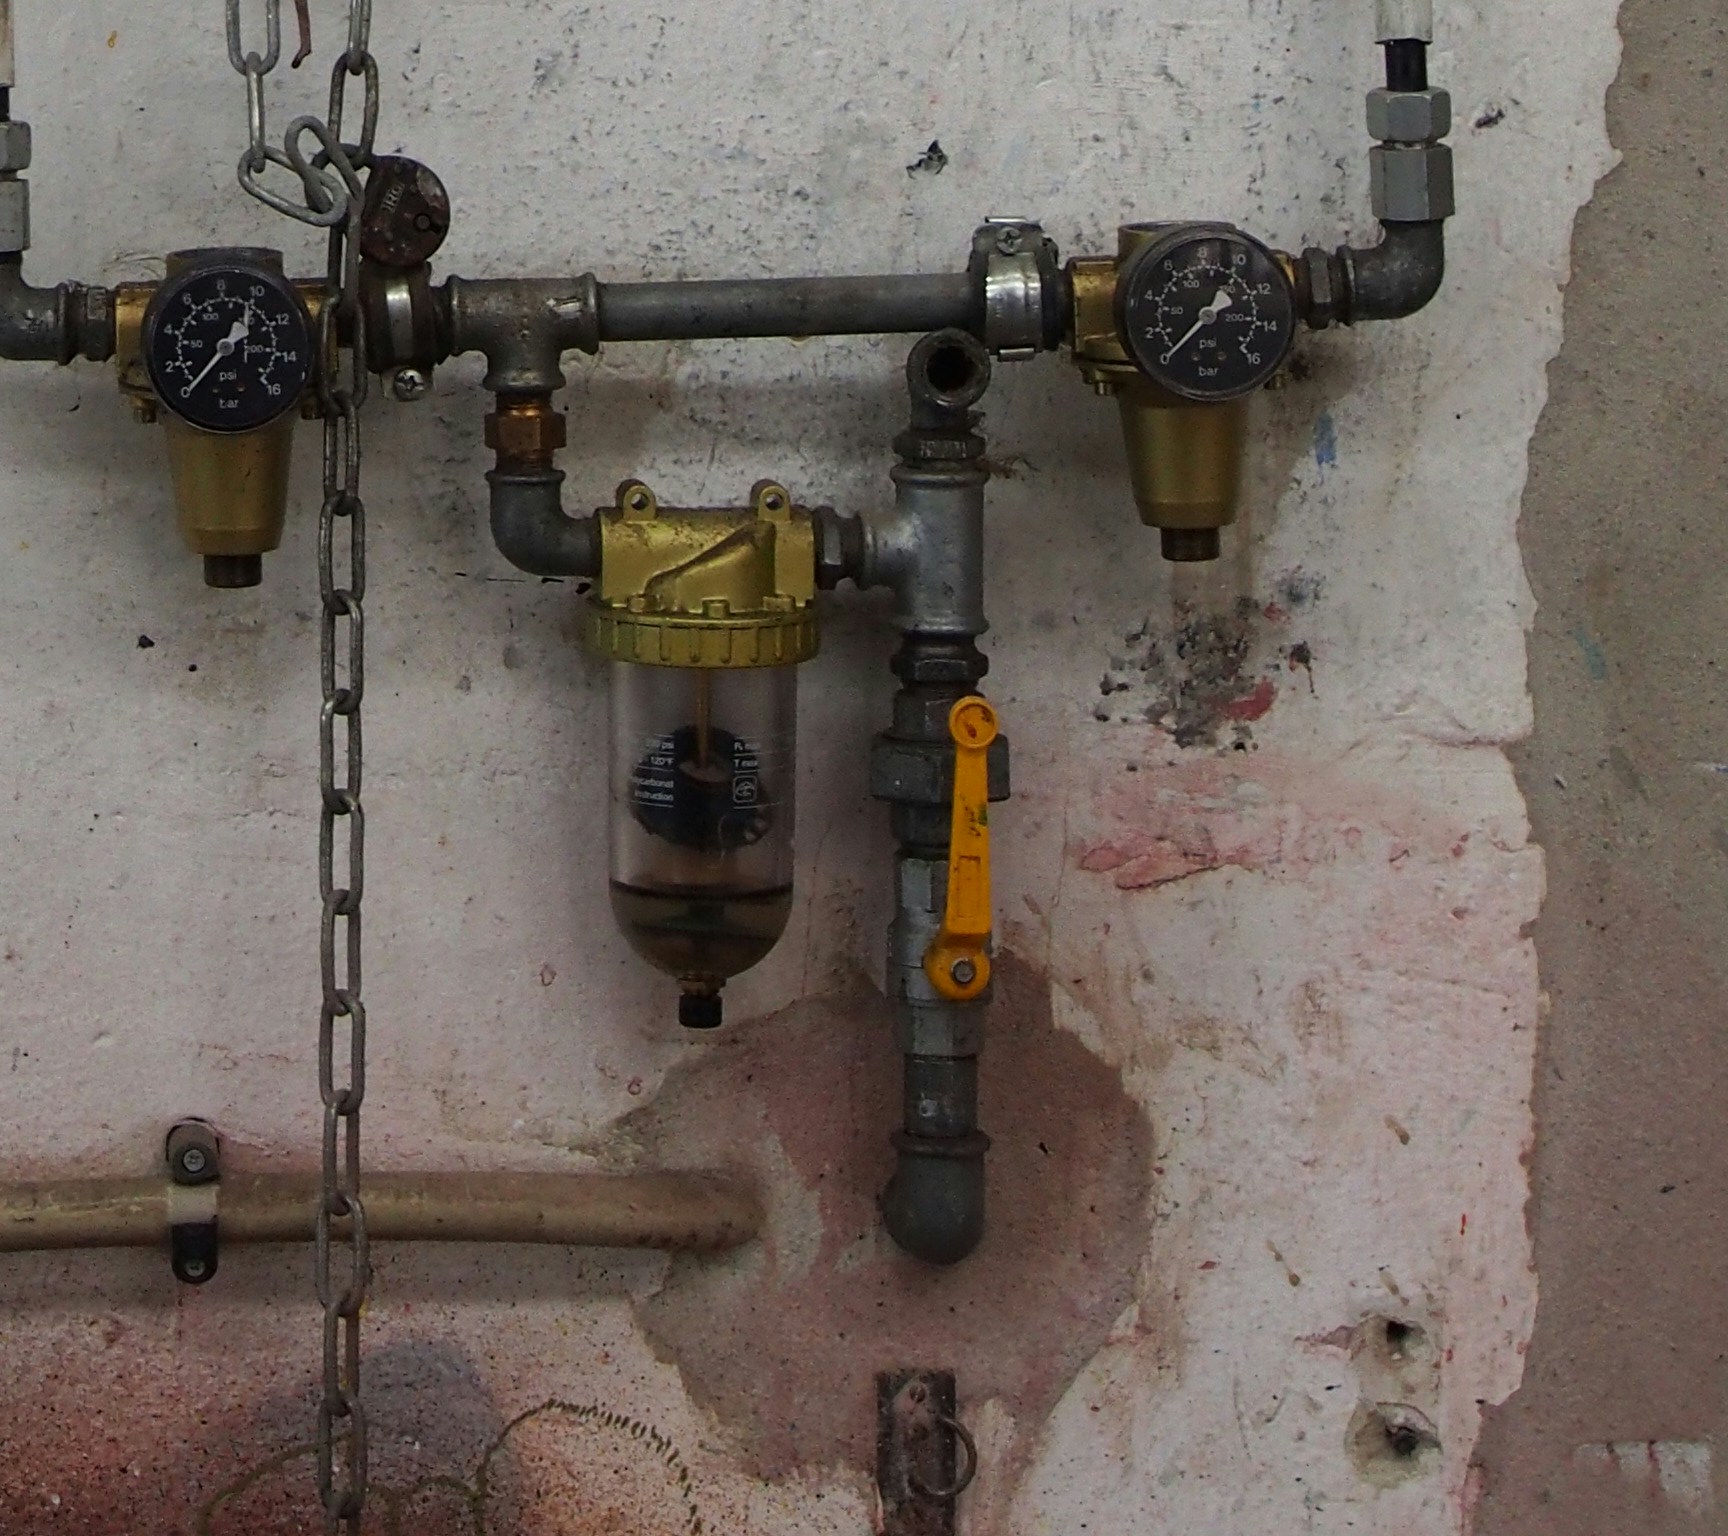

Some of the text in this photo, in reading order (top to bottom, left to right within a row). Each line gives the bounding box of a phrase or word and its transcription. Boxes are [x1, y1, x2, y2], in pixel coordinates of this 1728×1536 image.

[1231, 253, 1246, 266] 10
[1182, 279, 1200, 289] 100
[1257, 283, 1271, 296] 12
[249, 285, 265, 297] 10
[1144, 289, 1153, 301] 4
[202, 312, 219, 322] 100
[275, 313, 290, 325] 12
[1225, 312, 1244, 323] 200
[1262, 320, 1277, 332] 14
[1145, 327, 1154, 339] 2
[1198, 337, 1217, 349] psi
[282, 351, 297, 363] 14
[1246, 353, 1261, 365] 16
[165, 361, 174, 373] 2
[1198, 365, 1220, 377] bar
[218, 370, 237, 381] psi
[267, 383, 281, 396] 16
